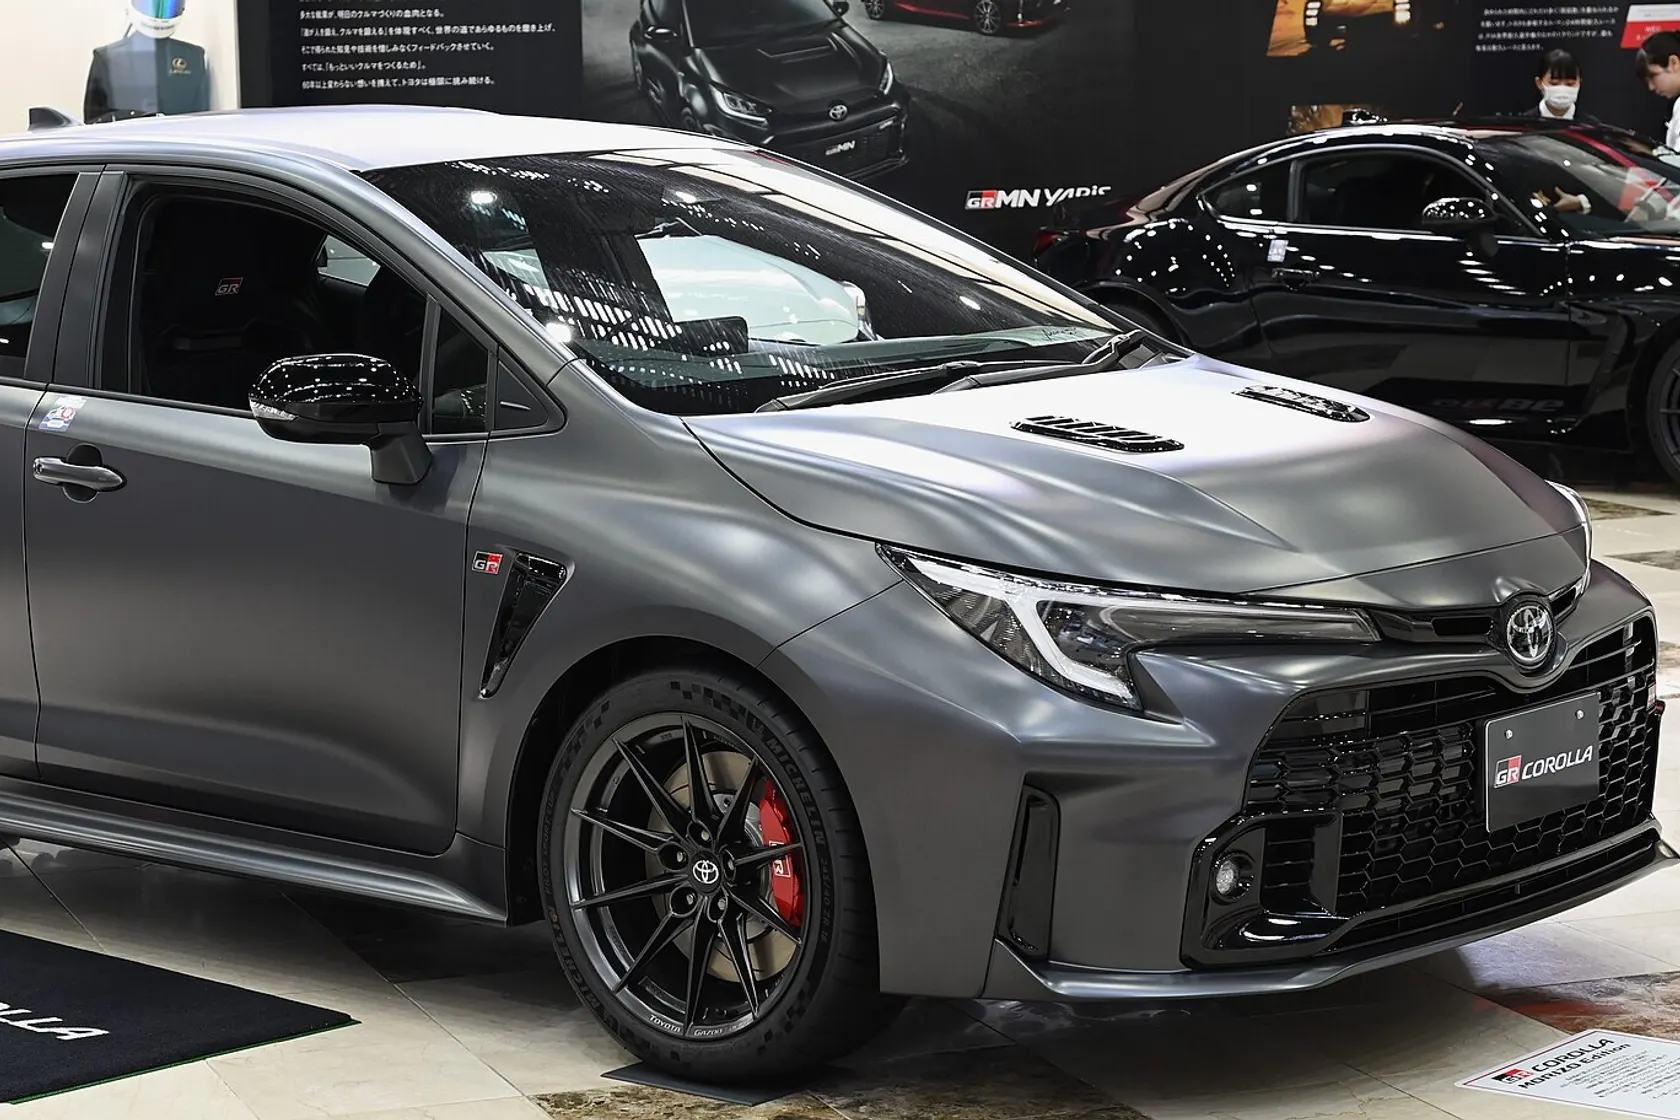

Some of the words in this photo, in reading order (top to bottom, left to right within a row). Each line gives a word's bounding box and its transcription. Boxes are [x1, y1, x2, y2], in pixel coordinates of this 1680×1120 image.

[966, 189, 1041, 209] GRMN
[216, 280, 242, 295] GR
[473, 556, 500, 574] GR
[1495, 761, 1520, 786] GR
[1522, 745, 1593, 779] COROLLA
[766, 738, 827, 846] MICHELIN
[0, 1002, 110, 1040] LLA
[649, 1014, 681, 1033] TOYOTA
[1517, 1063, 1582, 1089] MORIZO
[1580, 1042, 1632, 1065] Edition
[1532, 1038, 1615, 1073] COROLLA
